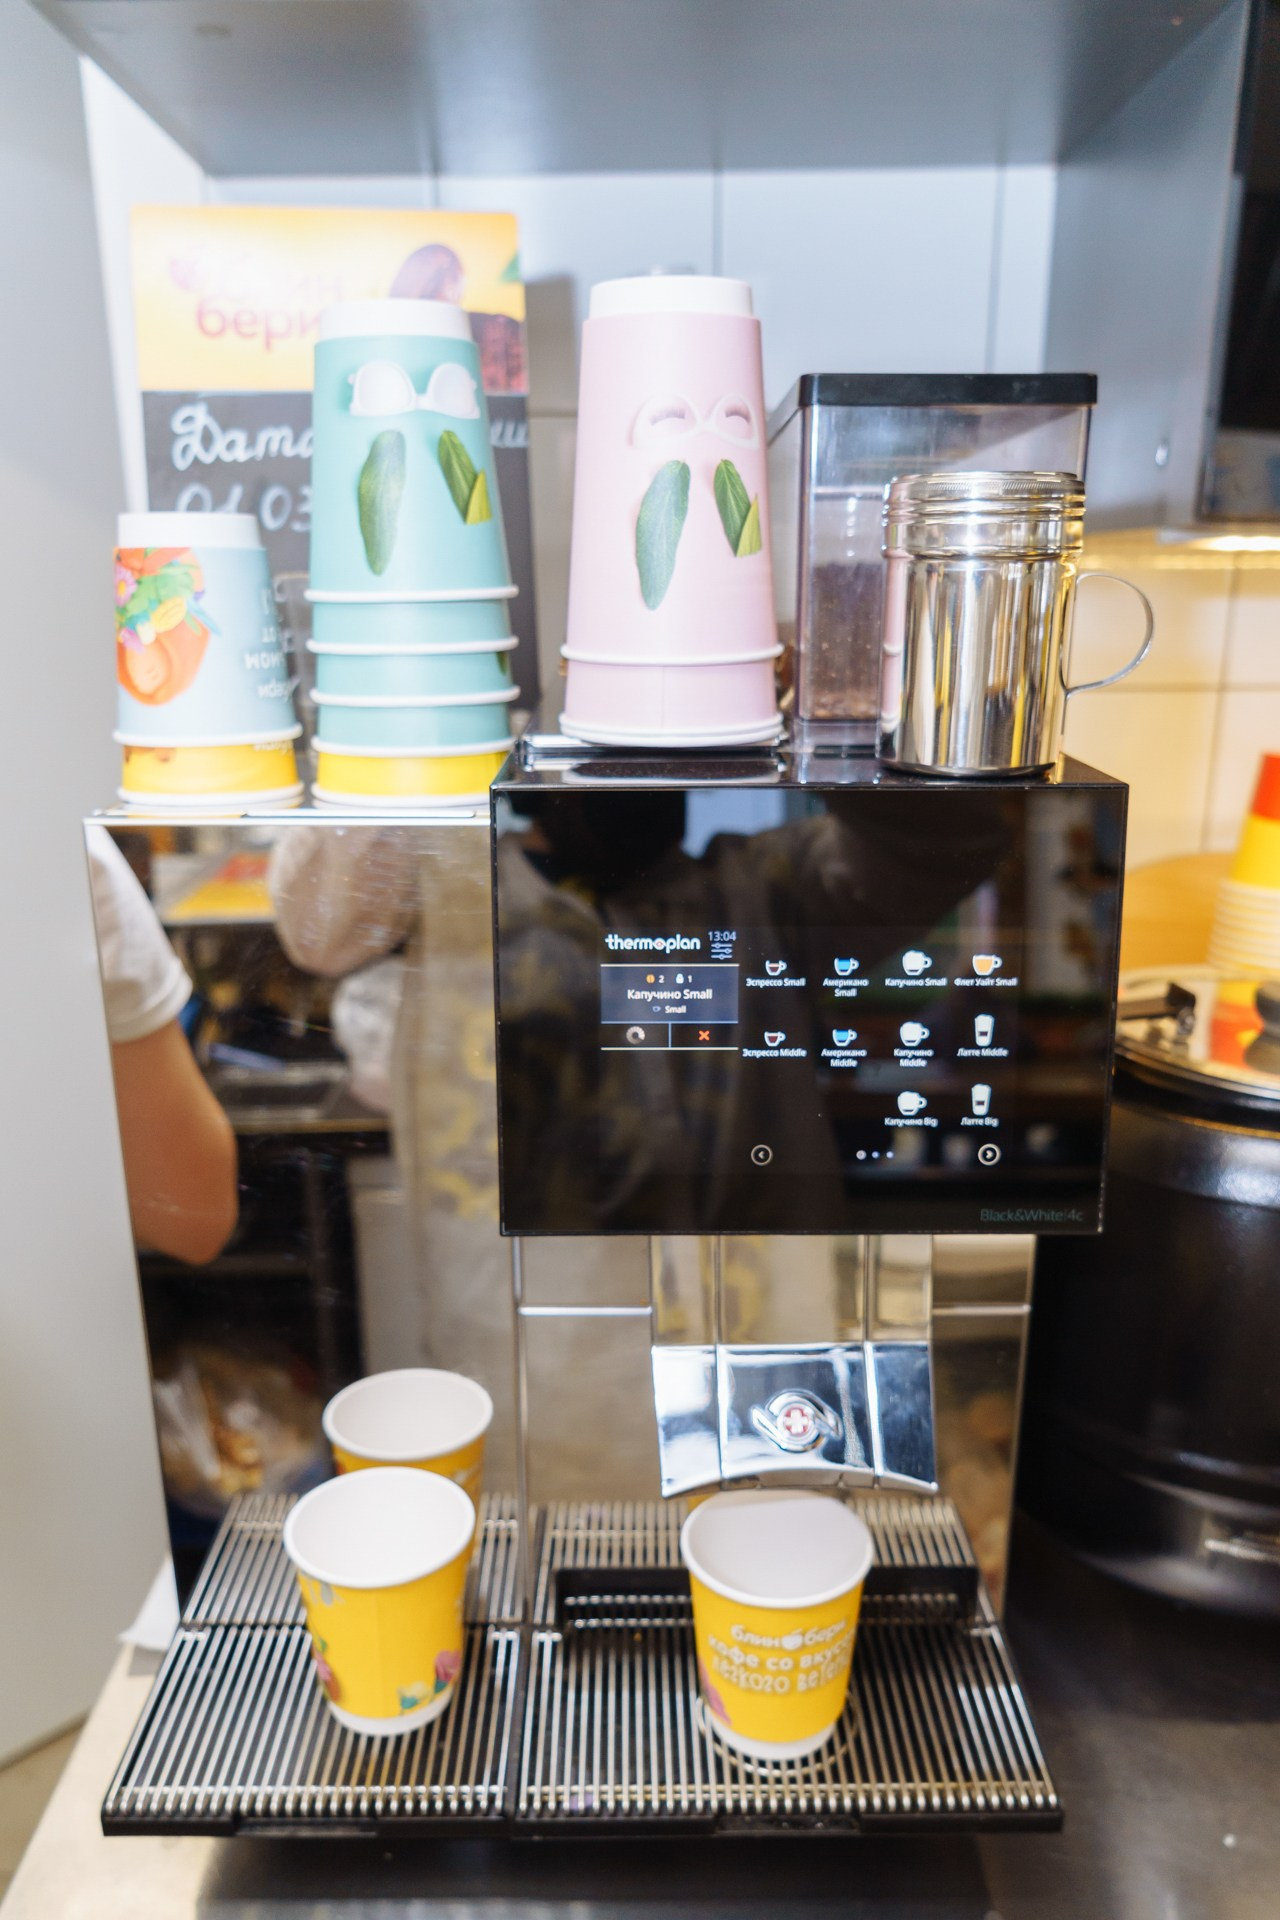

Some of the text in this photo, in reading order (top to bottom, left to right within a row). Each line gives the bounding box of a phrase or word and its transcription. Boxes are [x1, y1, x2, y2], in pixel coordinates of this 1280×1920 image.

[604, 930, 737, 953] thermoplan 13:04
[658, 974, 693, 984] 2 1
[745, 977, 806, 988] Эспрессо Small
[822, 977, 870, 988] Американо
[884, 977, 948, 988] Капучино Small
[995, 977, 1018, 987] Small
[627, 988, 713, 1002] Капучино Small
[834, 987, 858, 997] Small
[664, 1004, 687, 1014] Small
[742, 1048, 808, 1059] Эспрессо Middle
[820, 1048, 868, 1058] Американо
[893, 1048, 934, 1059] Капучино
[956, 1047, 1009, 1057] Латте Middle
[830, 1058, 858, 1068] Middle
[899, 1058, 928, 1068] Middle
[884, 1116, 939, 1128] Капучино Big
[960, 1116, 999, 1128] Латте Big
[766, 1657, 794, 1671] со
